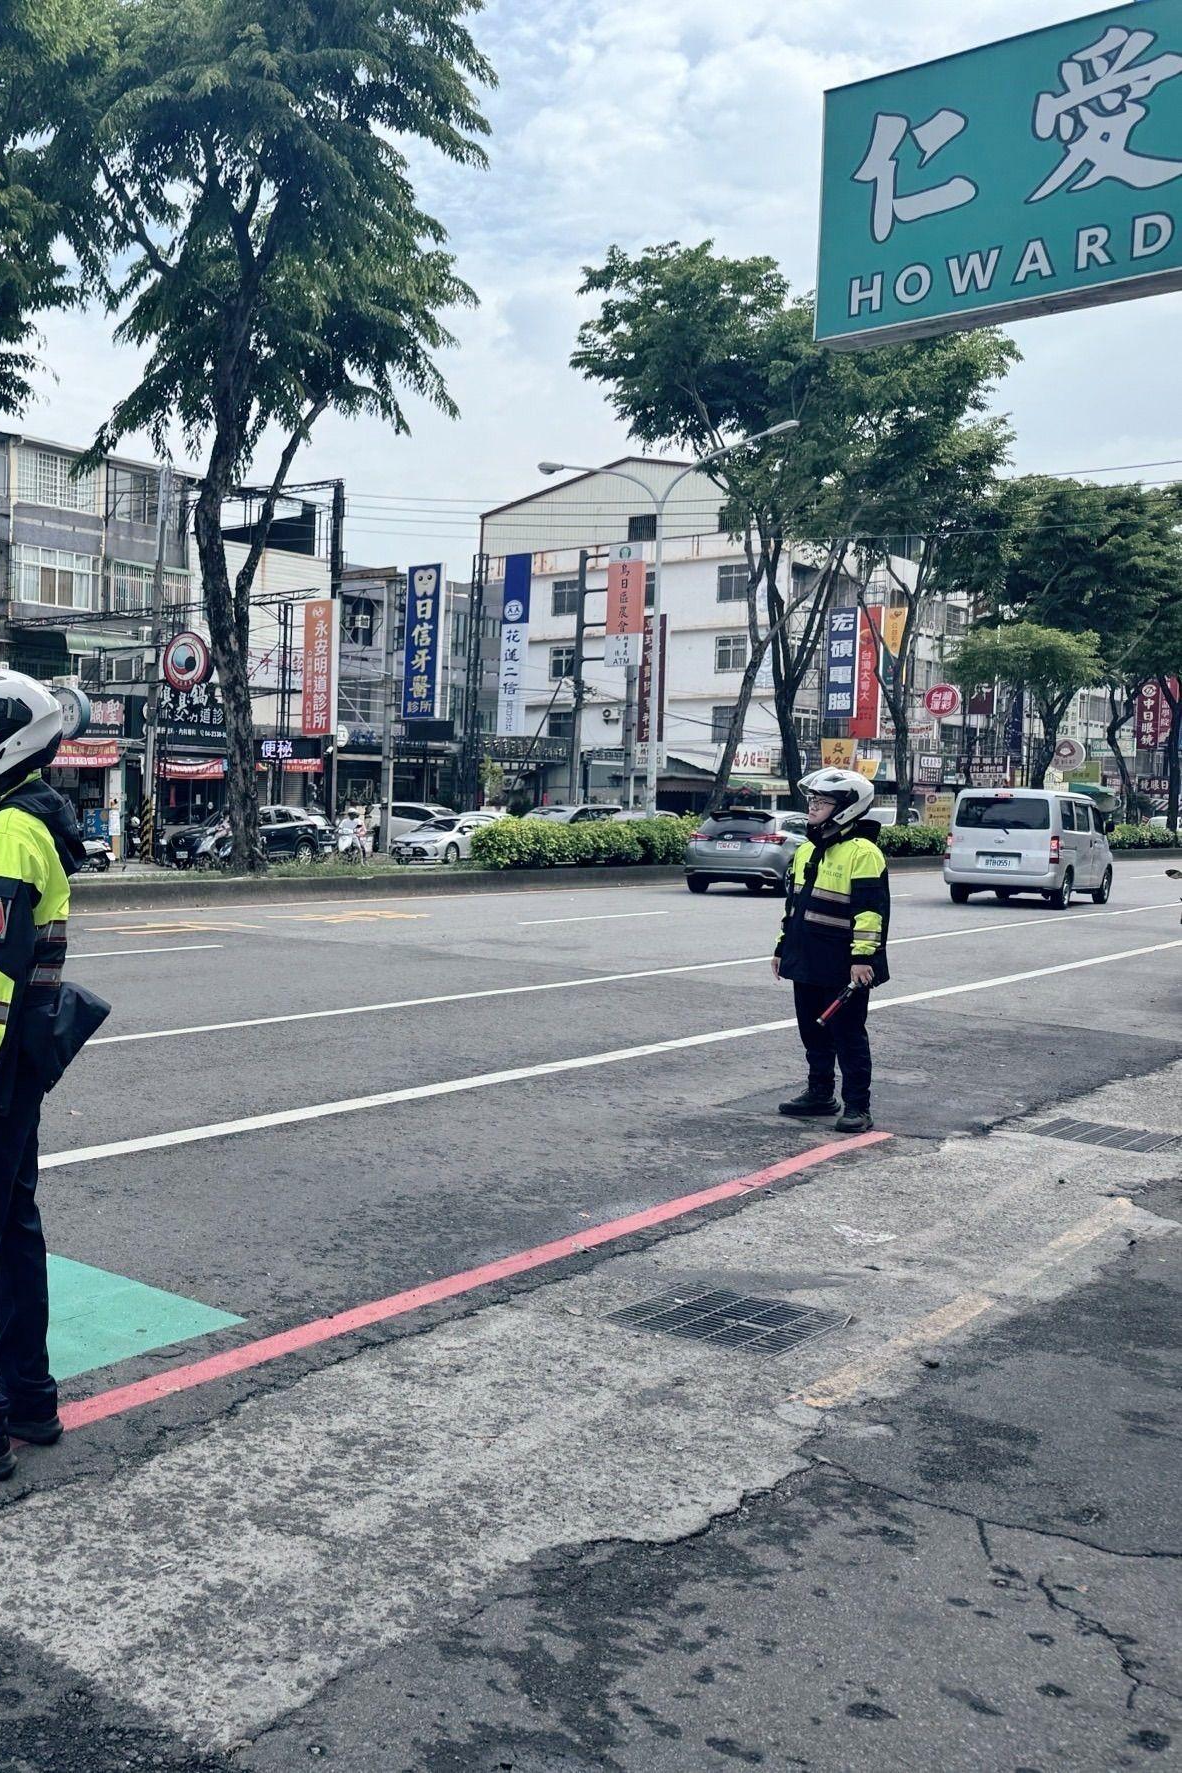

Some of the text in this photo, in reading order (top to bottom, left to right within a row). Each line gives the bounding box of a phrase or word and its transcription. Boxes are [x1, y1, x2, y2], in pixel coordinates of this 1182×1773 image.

[851, 26, 1182, 242] 仁愛
[849, 213, 1173, 316] HOWARD
[312, 620, 328, 729] 永安明道診所
[503, 630, 520, 695] 花蓮二信
[828, 613, 854, 711] 宏碩電腦
[861, 650, 870, 701] 台灣大哥大
[261, 740, 292, 758] 便秘
[1141, 699, 1155, 746] 中日眼鏡
